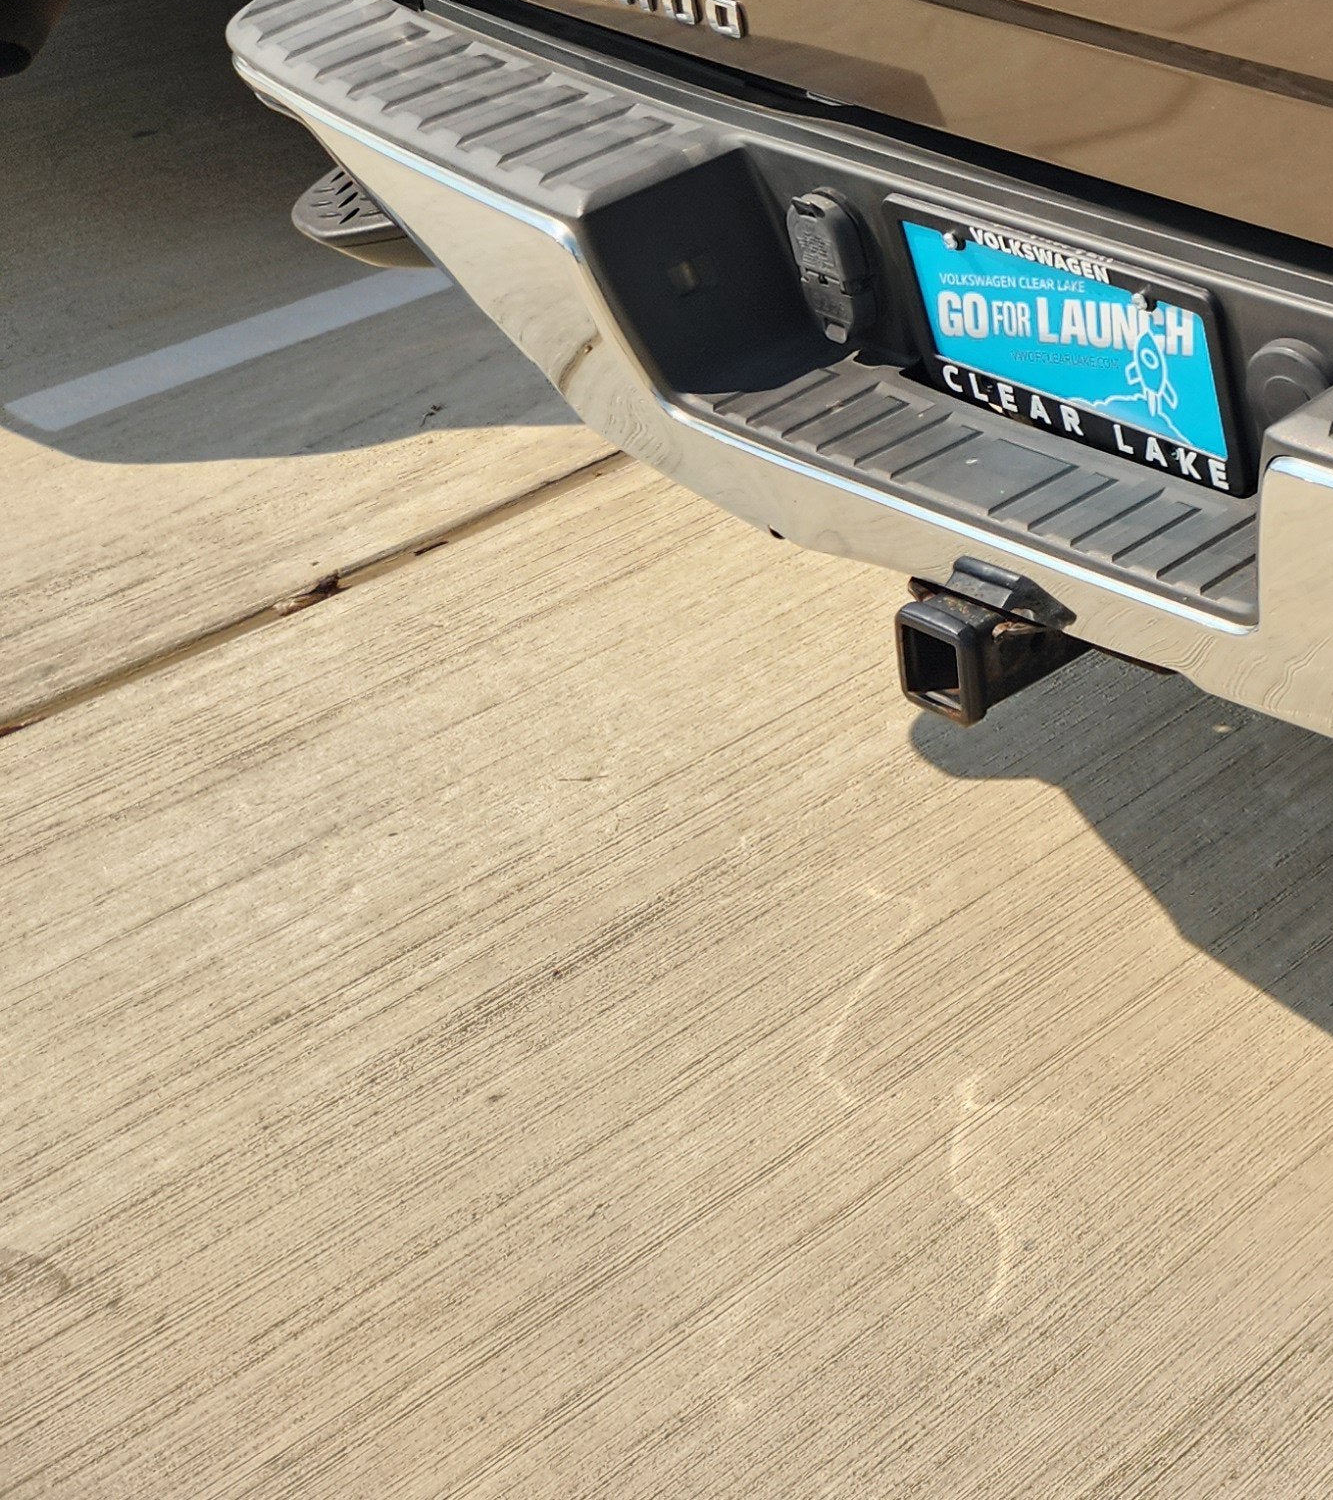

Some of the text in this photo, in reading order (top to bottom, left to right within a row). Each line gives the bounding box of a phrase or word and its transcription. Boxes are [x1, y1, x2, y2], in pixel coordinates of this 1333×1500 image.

[939, 272, 1085, 293] VOLKSWAGEN CLEAR LAKE
[969, 226, 1110, 285] VOLKSWAGEN
[937, 291, 1194, 357] GO FOR LAUNCH
[942, 365, 1230, 491] CLEAR LAKE
